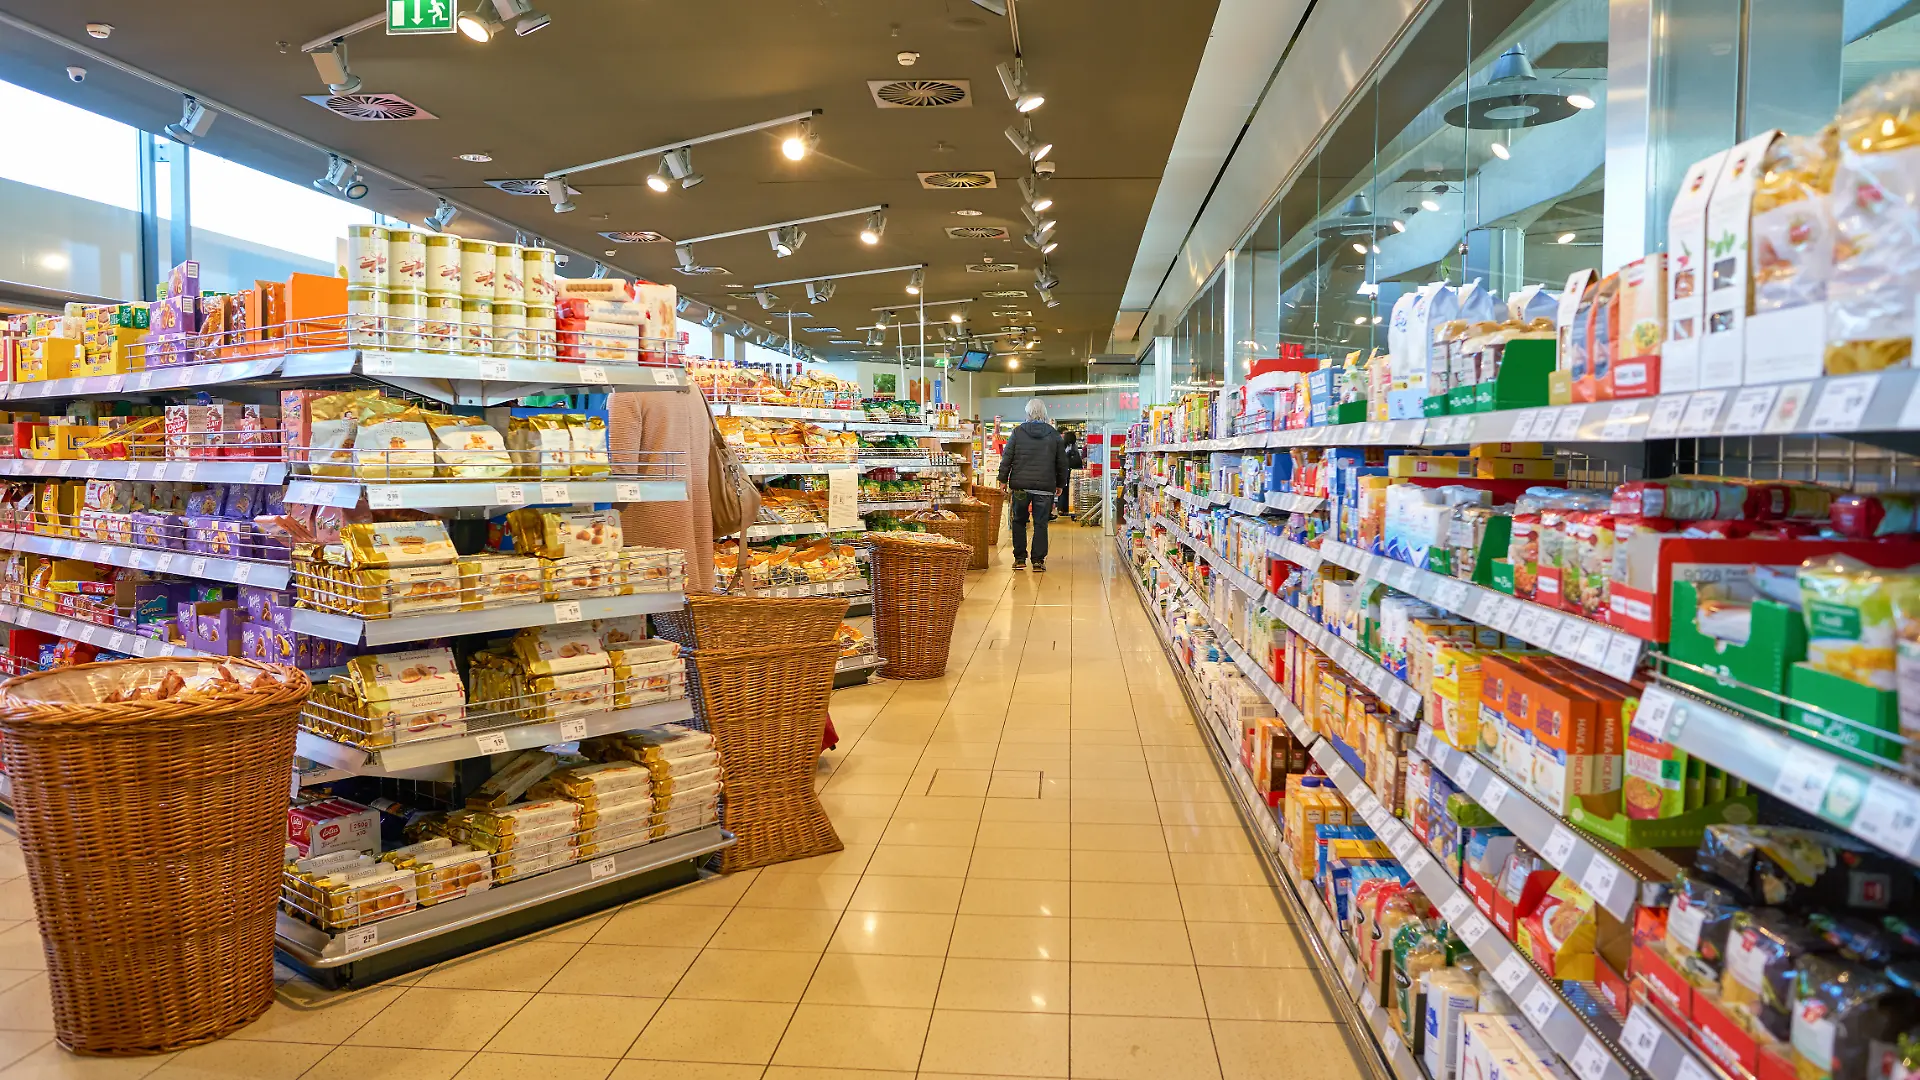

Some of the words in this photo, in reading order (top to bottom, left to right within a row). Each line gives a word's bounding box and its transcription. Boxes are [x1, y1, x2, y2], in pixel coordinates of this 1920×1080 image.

[1575, 718, 1586, 744] HAVE
[1603, 718, 1615, 744] HAVE
[1602, 778, 1612, 792] DA
[322, 827, 340, 838] Lotus
